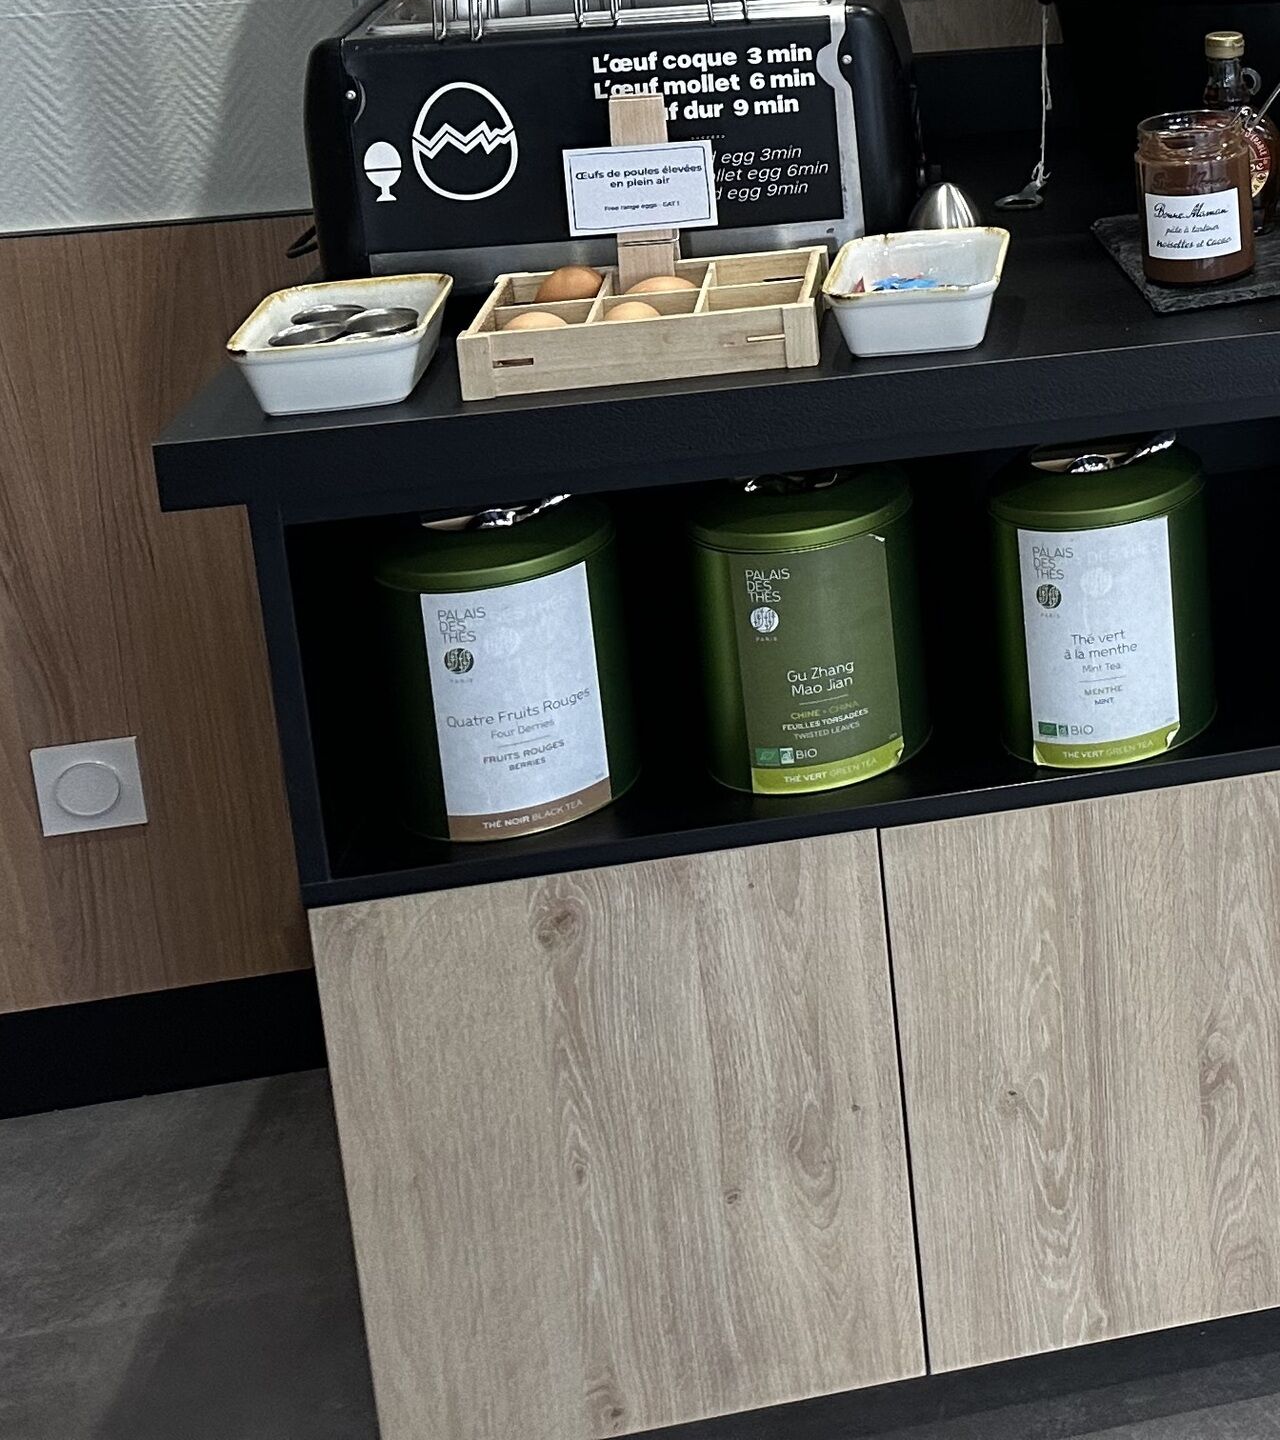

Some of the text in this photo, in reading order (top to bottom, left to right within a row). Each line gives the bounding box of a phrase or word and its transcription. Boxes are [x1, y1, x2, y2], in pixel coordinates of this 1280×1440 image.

[663, 50, 737, 72] coque
[746, 47, 762, 64] 3
[767, 43, 813, 64] min
[663, 73, 740, 96] mollet
[750, 72, 765, 90] 6
[770, 68, 816, 88] min
[683, 101, 724, 120] dur
[733, 98, 749, 116] 9
[754, 95, 799, 116] min
[721, 150, 755, 166] egg
[606, 169, 621, 179] de
[624, 166, 660, 179] poules
[662, 163, 702, 174] élevées
[747, 167, 781, 183] egg
[610, 175, 670, 189] en plein air
[727, 185, 761, 203] egg
[1154, 202, 1229, 219] Bonne Maman
[1032, 546, 1074, 559] PALAIS
[1033, 558, 1056, 569] DES
[745, 567, 791, 580] PALAIS
[747, 580, 772, 592] DES
[437, 606, 487, 620] PALAIS
[439, 620, 466, 633] DES
[1071, 629, 1126, 645] Thé vert
[1064, 643, 1138, 660] à la menthe
[787, 661, 854, 683] Gu Zhang
[1082, 662, 1121, 674] Mint Tea
[791, 676, 853, 697] Mao Jian
[1084, 684, 1123, 696] MENTHE
[446, 688, 591, 729] Quatre Fruits Rouges
[790, 709, 821, 720] CHINE
[490, 725, 515, 739] Four
[782, 719, 821, 731] FEUILLES
[793, 721, 861, 740] TWISTED LEAVES
[1070, 724, 1094, 736] BIO
[483, 739, 566, 765] FRUITS ROUGES
[795, 748, 818, 760] BIO
[1081, 749, 1104, 759] VERT
[1137, 739, 1154, 750] TEA
[509, 757, 546, 771] BERRIES
[803, 771, 829, 782] VERT
[861, 758, 878, 769] TEA
[504, 816, 530, 828] NOIR
[531, 807, 566, 821] BLACK
[565, 798, 583, 812] TEA
